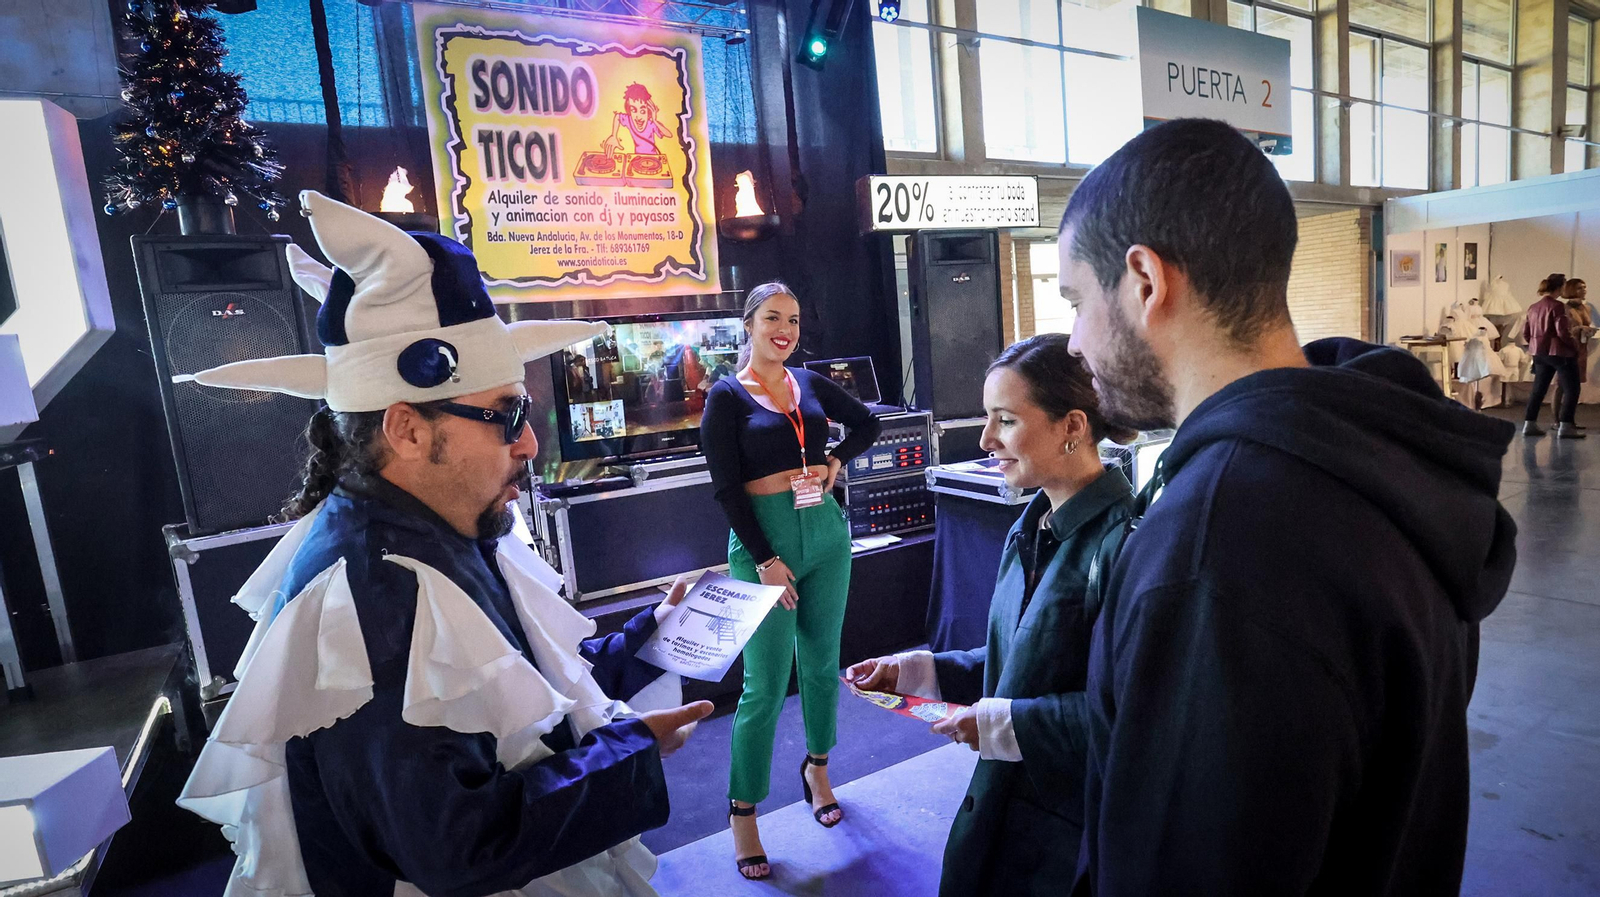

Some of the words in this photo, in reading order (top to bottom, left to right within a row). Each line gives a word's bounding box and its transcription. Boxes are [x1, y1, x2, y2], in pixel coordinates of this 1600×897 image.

[471, 58, 594, 115] SONIDO
[1167, 61, 1247, 104] PUERTA
[1261, 79, 1272, 108] 2
[477, 129, 560, 182] TICOI
[487, 189, 538, 208] Alquiler
[543, 190, 559, 205] de
[565, 191, 608, 207] sonido,
[614, 191, 676, 206] iluminacion
[1007, 181, 1025, 200] boda
[877, 181, 935, 223] 20%
[491, 212, 500, 226] y
[506, 208, 568, 222] animacion
[573, 212, 594, 222] con
[599, 208, 613, 226] dj
[617, 212, 625, 226] y
[630, 212, 675, 226] payasos
[1014, 203, 1035, 222] stand
[487, 231, 506, 242] Bda.
[508, 231, 535, 242] Nueva
[537, 231, 578, 242] Andalucia,
[580, 231, 591, 241] Av.
[593, 231, 603, 241] de
[604, 230, 616, 241] los
[617, 231, 665, 241] Monumentos,
[667, 230, 684, 240] 18-D
[530, 244, 551, 255] Jerez
[552, 244, 562, 254] de
[564, 244, 572, 254] la
[574, 244, 589, 254] Fra.
[596, 243, 608, 253] Tlf:
[610, 243, 650, 253] 689361769
[557, 256, 627, 267] www.sonidoticoi.es
[699, 590, 728, 604] JEREZ
